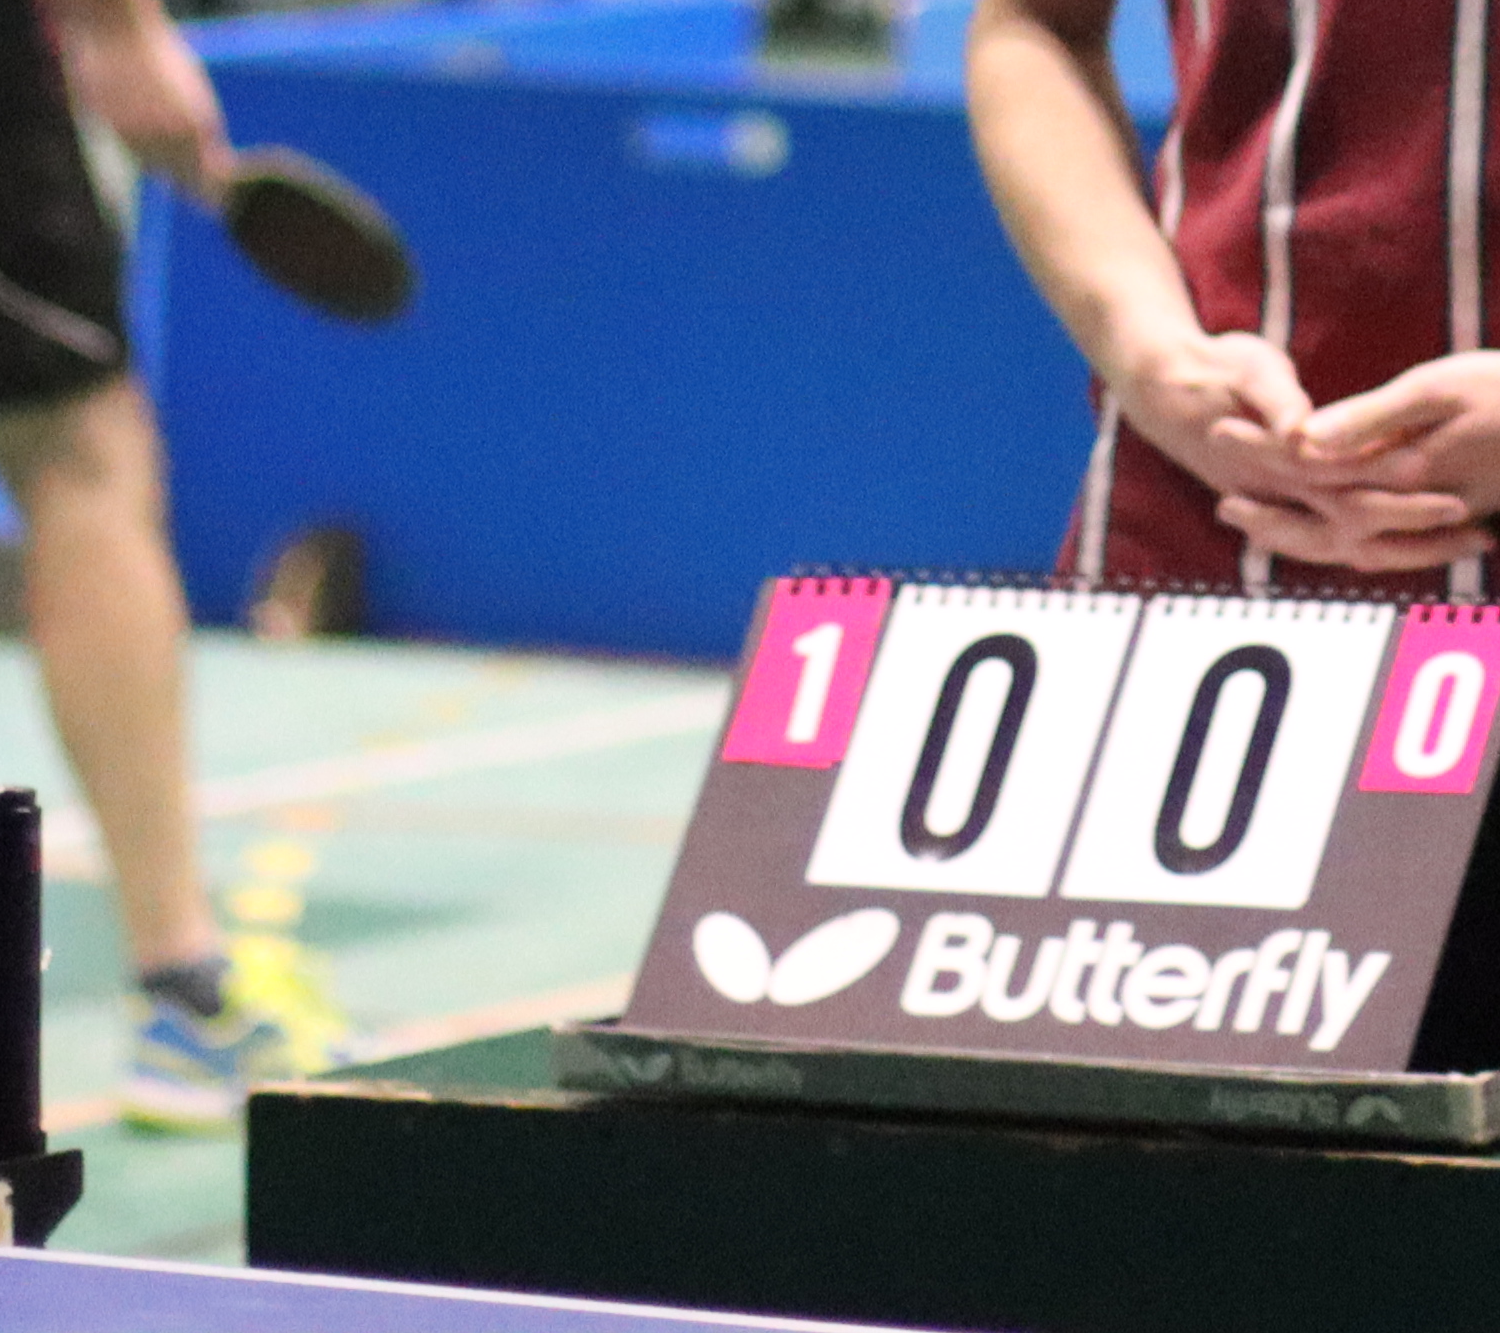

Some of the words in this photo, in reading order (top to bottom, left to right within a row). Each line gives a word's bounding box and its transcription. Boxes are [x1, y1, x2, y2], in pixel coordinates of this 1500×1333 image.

[786, 620, 844, 746] 1
[899, 632, 1038, 860] 0
[1153, 644, 1292, 875] 0
[1392, 649, 1487, 780] 0
[898, 909, 1392, 1052] Butterfly
